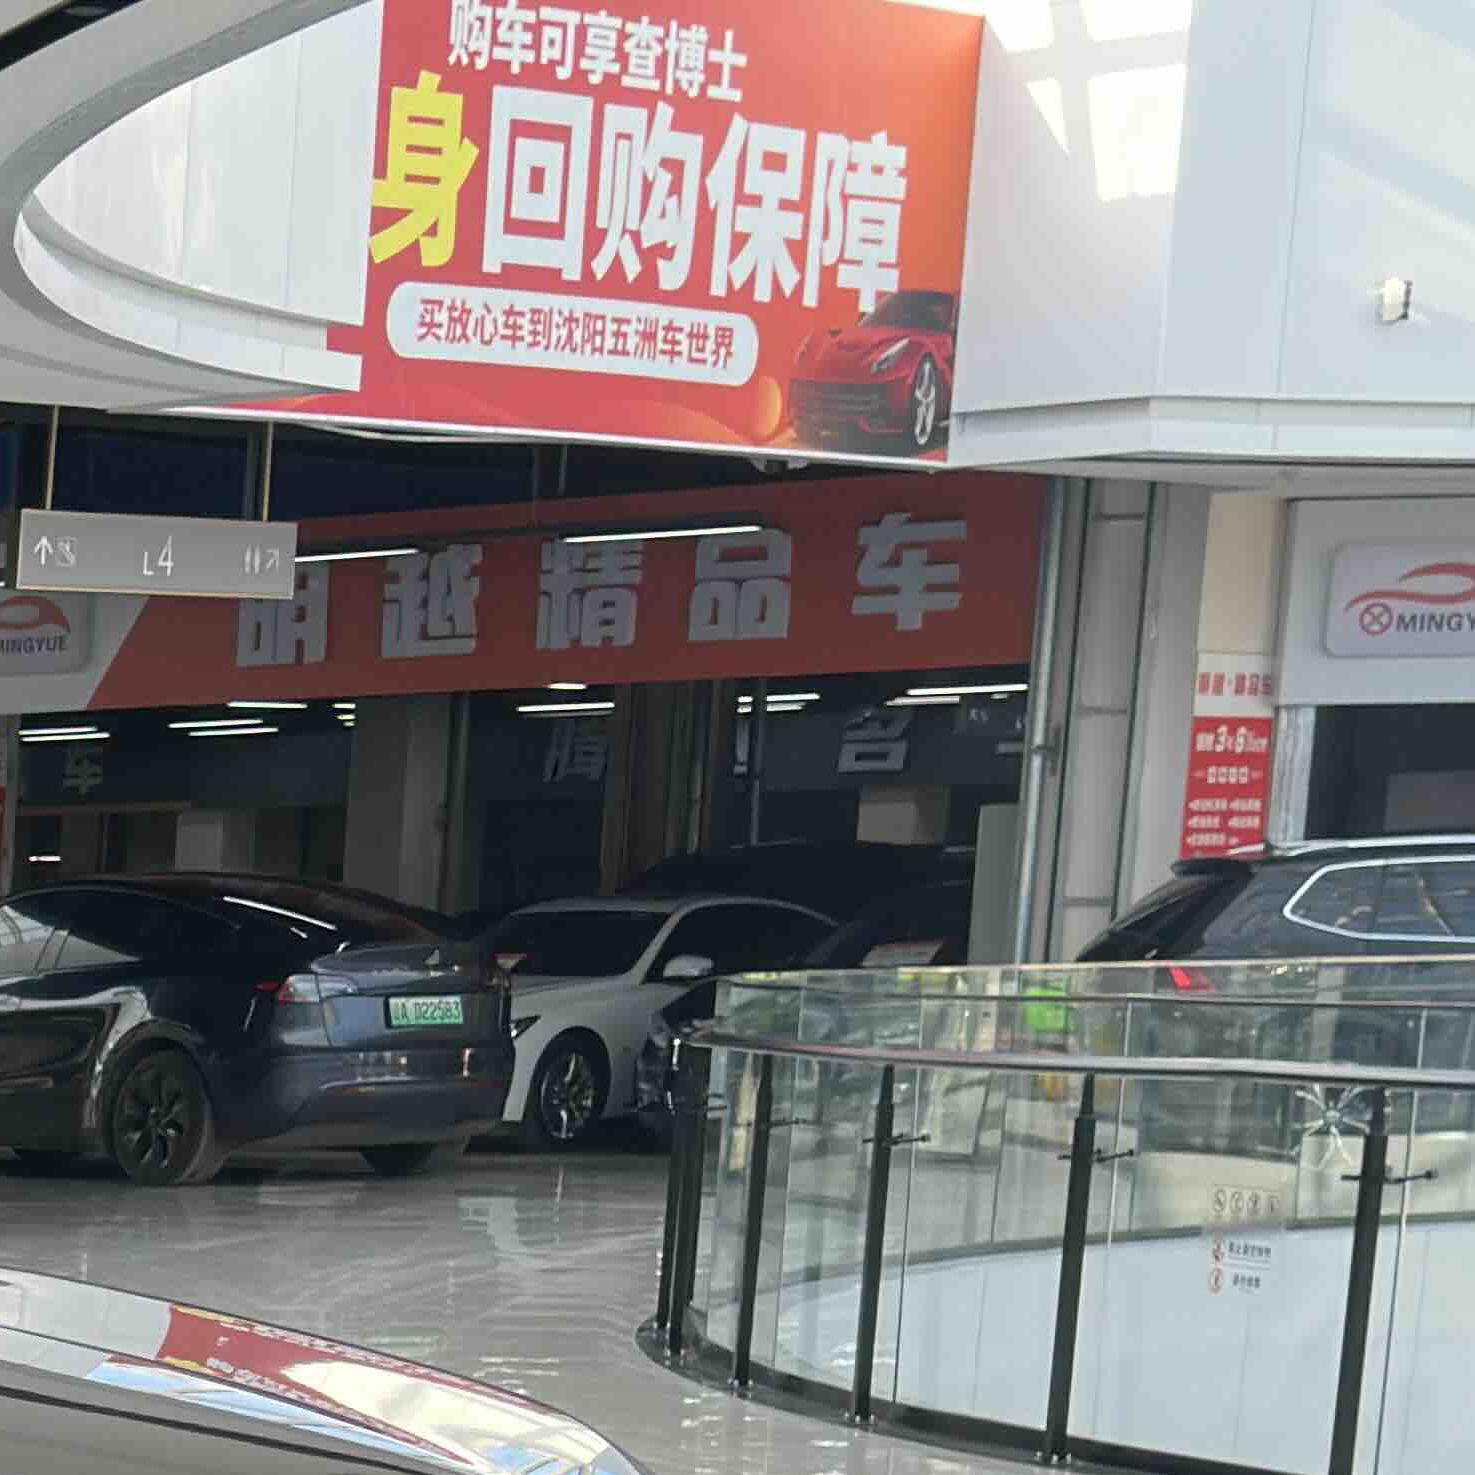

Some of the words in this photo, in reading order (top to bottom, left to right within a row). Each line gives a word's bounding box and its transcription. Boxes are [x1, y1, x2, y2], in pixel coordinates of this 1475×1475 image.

[448, 0, 748, 103] 购车可享查博士
[369, 70, 908, 313] 身回购保障
[416, 297, 736, 369] 买放心车到沈阳五洲车世界
